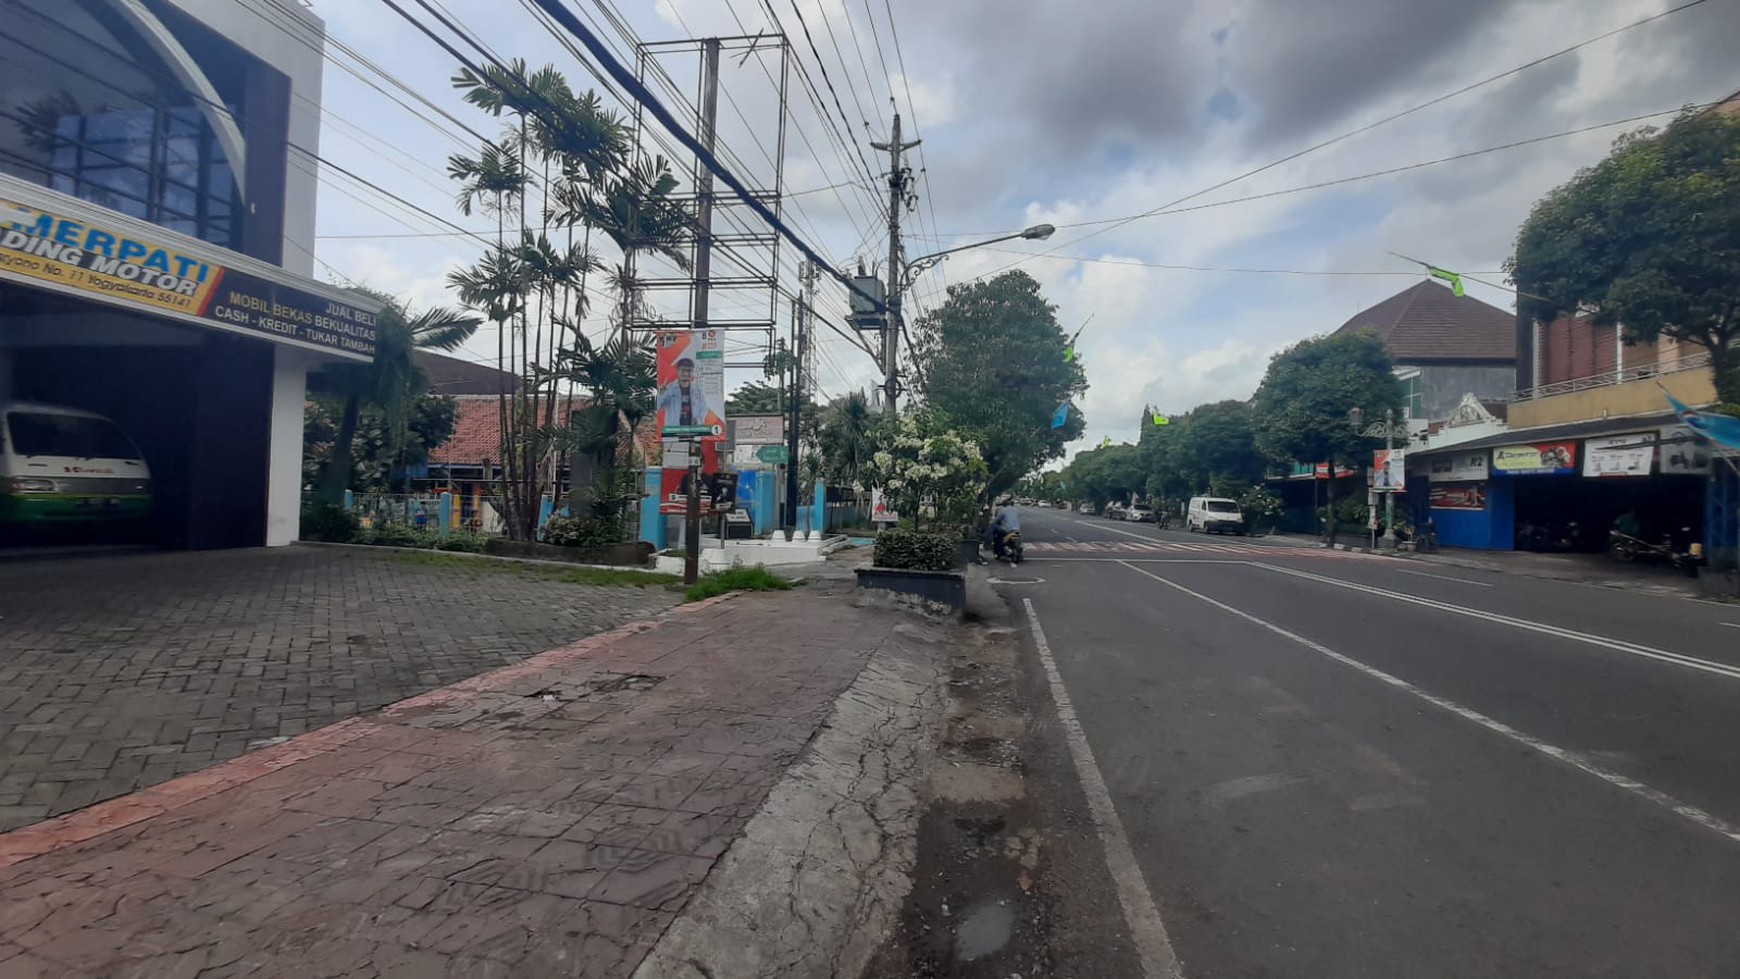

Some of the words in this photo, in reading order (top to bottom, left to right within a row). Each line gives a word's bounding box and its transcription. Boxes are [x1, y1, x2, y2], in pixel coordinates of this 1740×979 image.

[0, 230, 83, 266] DING
[89, 255, 198, 297] MOTOR
[12, 207, 208, 283] MERPATI
[88, 275, 154, 299] Yogyakarta
[157, 293, 191, 308] 55141
[229, 291, 271, 314] MOBIL
[272, 304, 313, 325] BEKAS
[315, 315, 377, 340] BEKUALITAS
[326, 302, 352, 320] JUAL
[354, 310, 377, 327] BELI
[215, 305, 250, 324] CASH
[258, 317, 298, 336] KREDIT
[306, 329, 338, 345] TUKAR
[341, 338, 376, 355] TAMBAH
